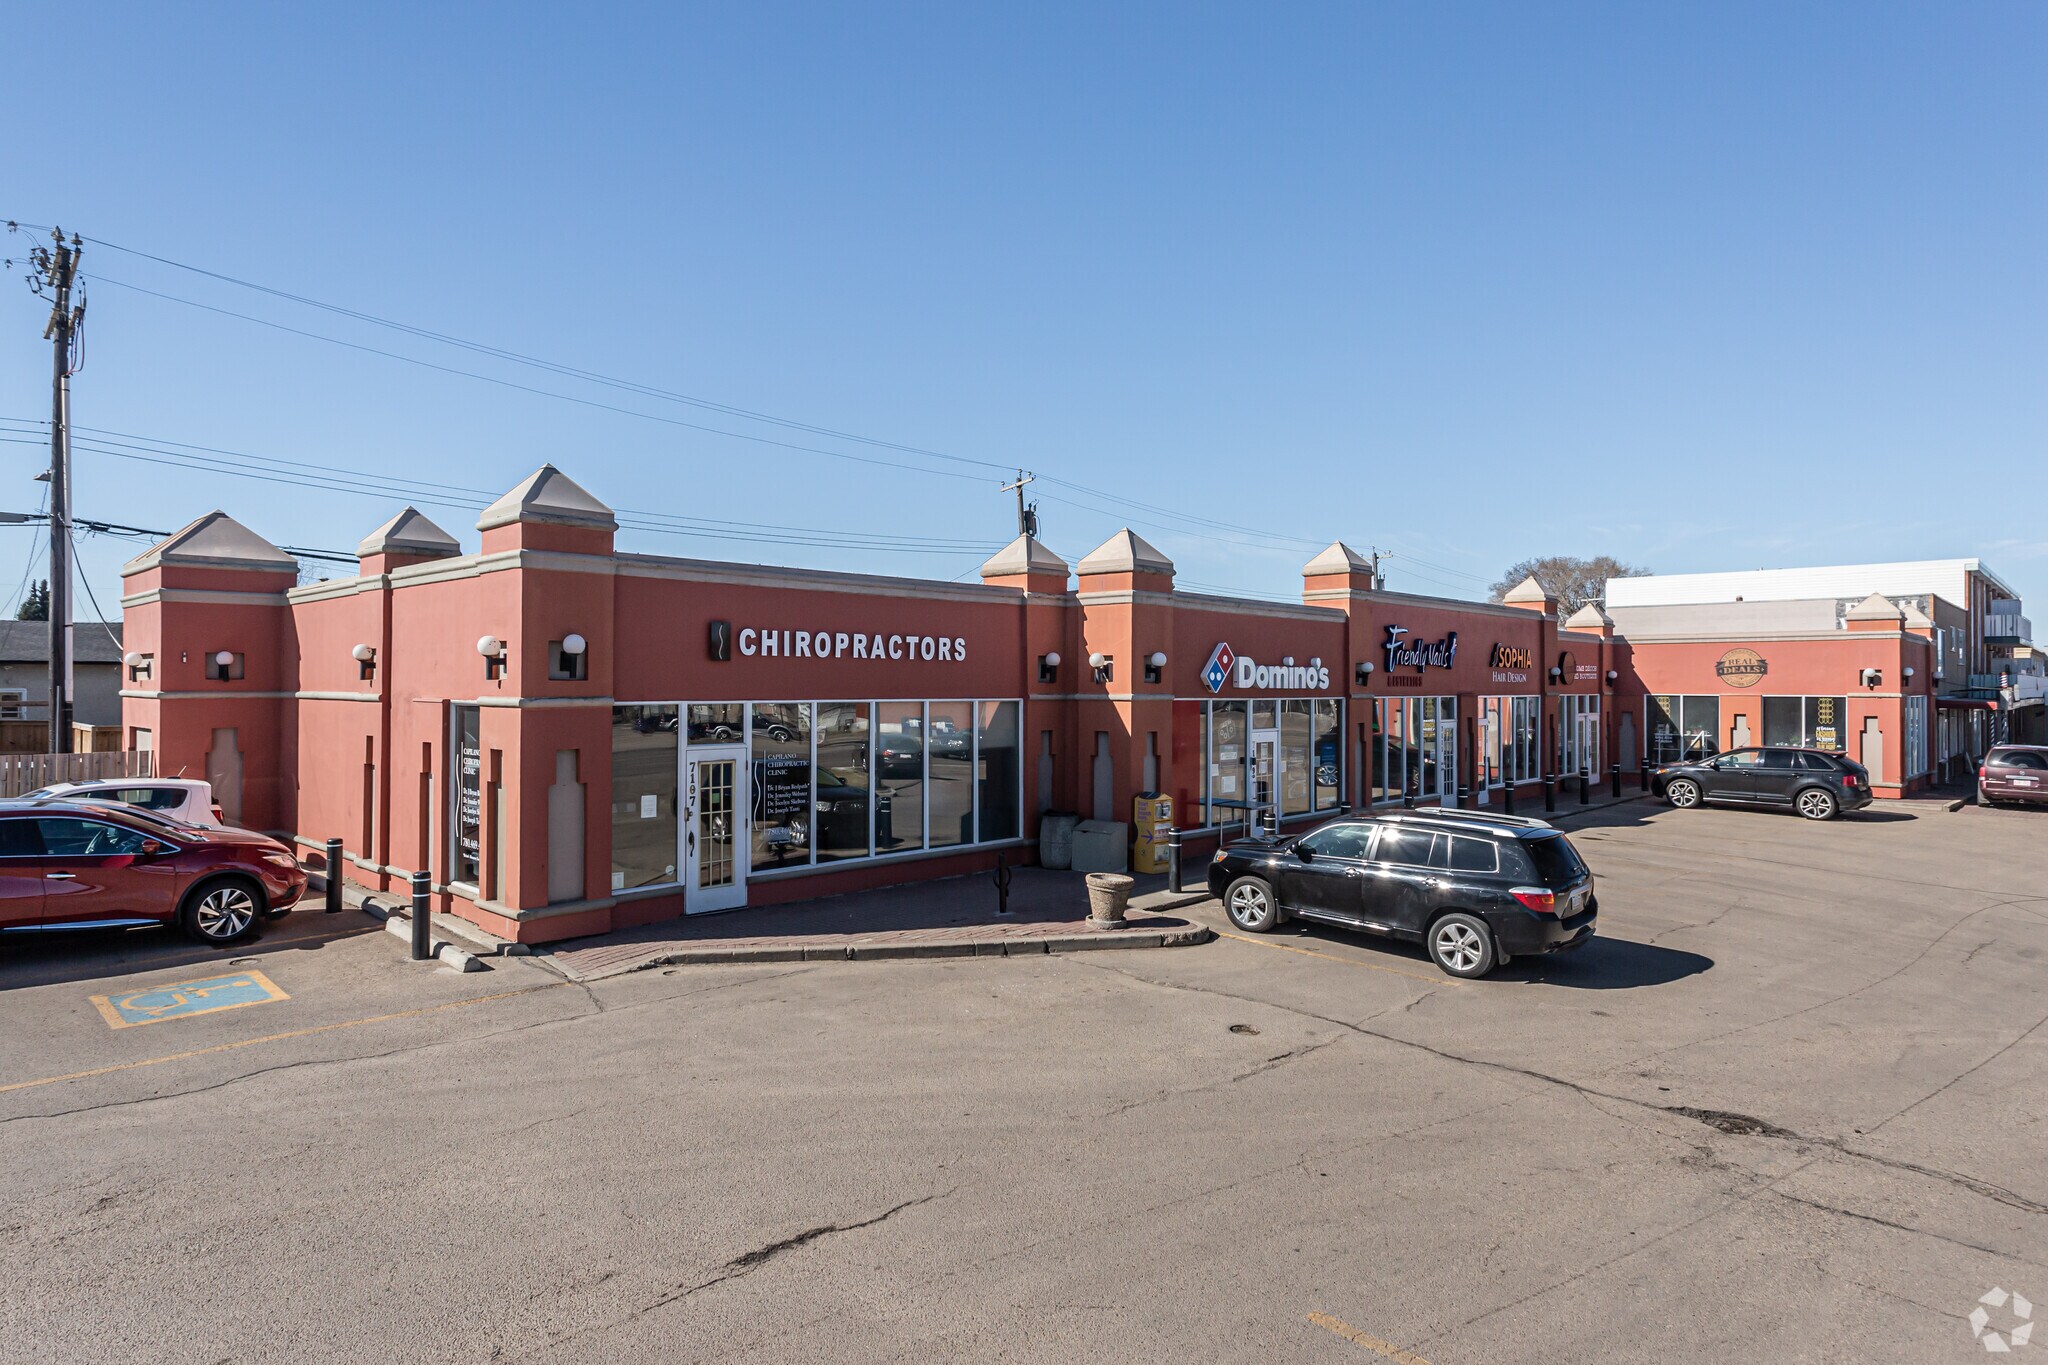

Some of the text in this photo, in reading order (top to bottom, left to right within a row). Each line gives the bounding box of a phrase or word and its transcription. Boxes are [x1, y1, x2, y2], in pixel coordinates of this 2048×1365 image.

[739, 628, 966, 661] CHIROPRACTORS
[1386, 625, 1427, 672] Friendly
[1499, 647, 1532, 668] SOPHIA
[1234, 656, 1329, 689] Domino's
[1723, 666, 1761, 674] DEALS
[768, 760, 810, 768] CHIROPRACTIC
